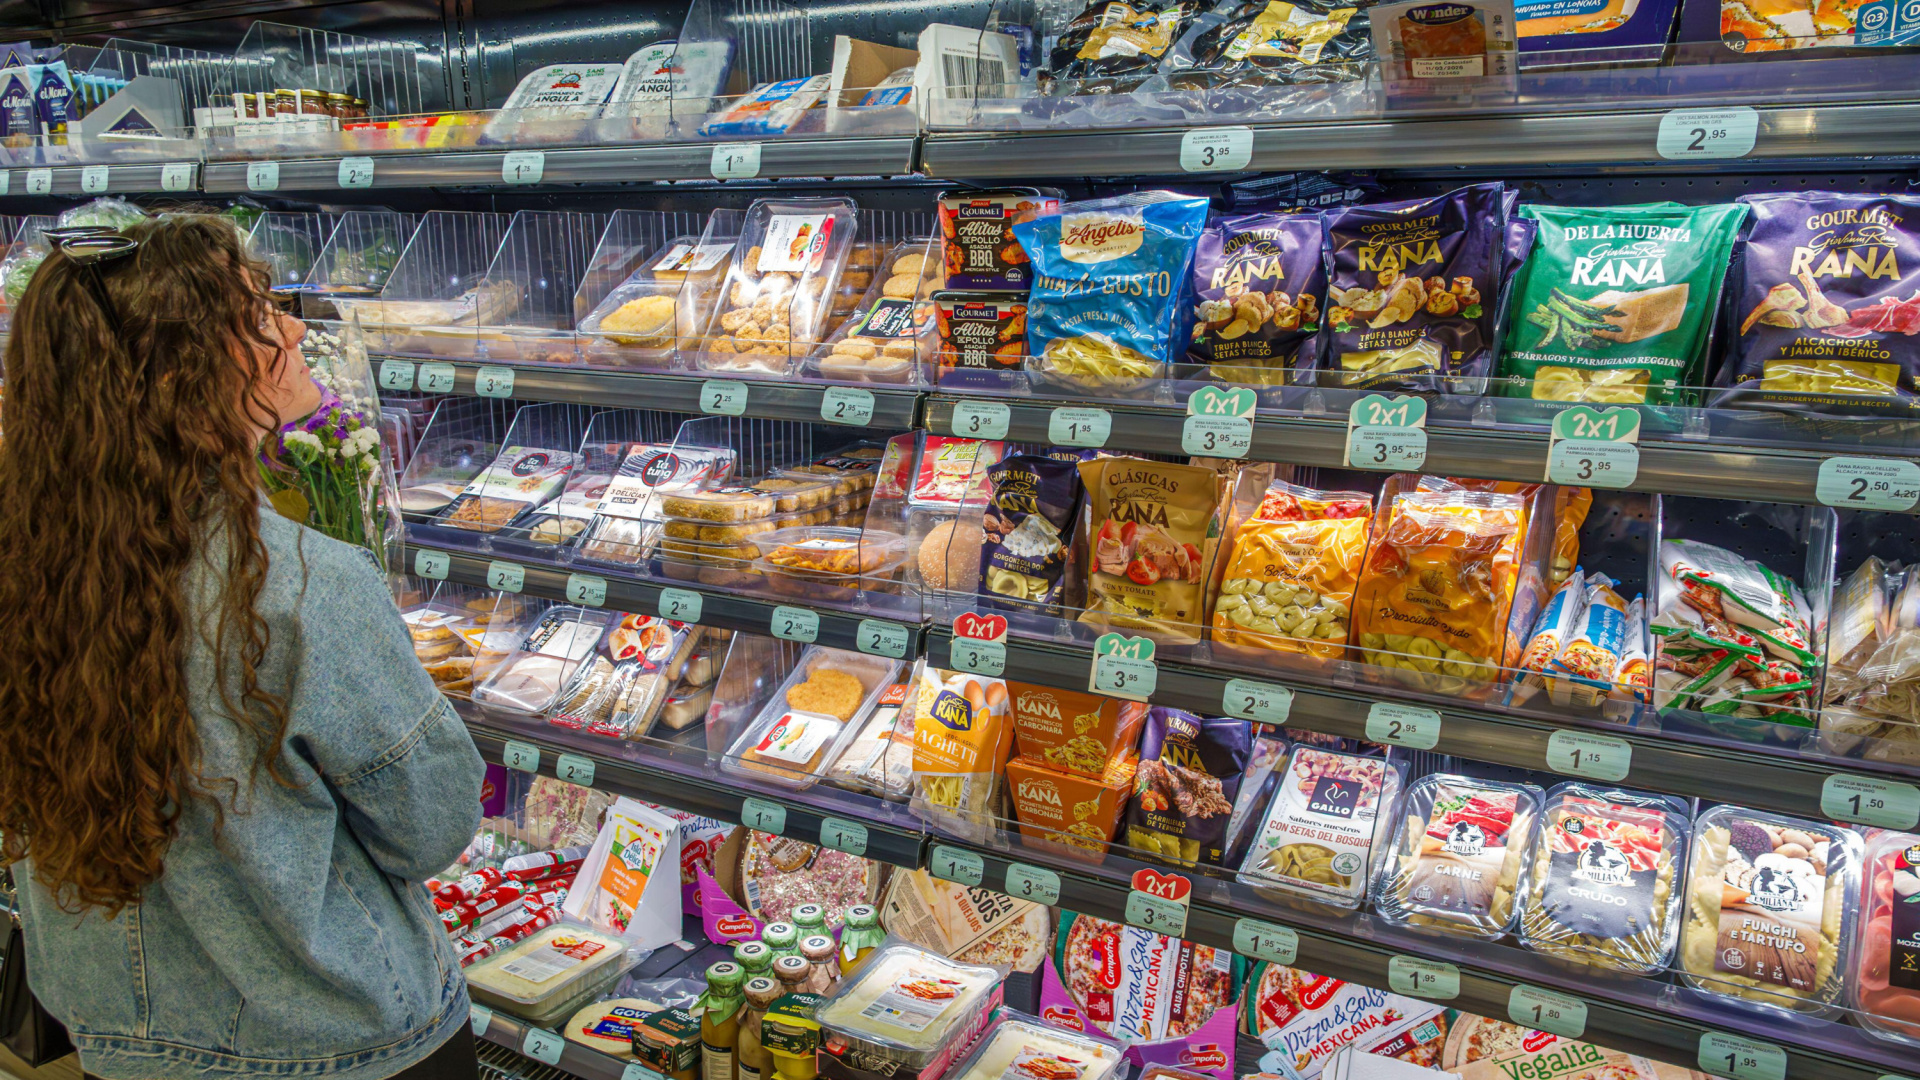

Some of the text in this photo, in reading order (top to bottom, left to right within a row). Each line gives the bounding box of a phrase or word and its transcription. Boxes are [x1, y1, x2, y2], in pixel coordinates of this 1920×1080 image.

[1412, 6, 1468, 20] Wonder
[1515, 4, 1551, 13] AHUMADO
[958, 221, 1003, 235] Alitas
[1361, 214, 1440, 234] GOURMET
[1806, 208, 1903, 231] GOURMET
[1065, 220, 1139, 246] Angelis
[1223, 229, 1283, 256] GOURMET
[1564, 224, 1692, 243] DE LA HUERTA
[970, 250, 993, 267] BBQ
[1358, 240, 1444, 272] RANA
[1789, 246, 1901, 281] RANA
[1211, 258, 1285, 289] RANA
[1570, 257, 1667, 286] RANA
[1102, 271, 1171, 298] GUSTO
[953, 322, 998, 336] Alitas
[1061, 311, 1109, 330] PASTA FRESCA
[1214, 342, 1240, 352] TRUFA
[1358, 339, 1384, 349] SETAS
[1360, 332, 1386, 342] TRUFA
[1794, 337, 1879, 349] ALCACHOFAS
[964, 350, 987, 367] BBQ
[1213, 351, 1237, 360] SETAS
[1247, 347, 1272, 357] QUESO
[1780, 344, 1891, 359] Y JAMÓN IBÉRICO
[1568, 356, 1686, 368] Y PARMIGIANO REGGIANO
[1204, 392, 1240, 415] 2x1
[1861, 400, 1890, 408] RECETA
[1368, 402, 1408, 426] 2x1
[1572, 413, 1619, 439] 2x1
[990, 470, 1040, 485] GOURMET
[1108, 468, 1179, 494] CLÁSICAS
[616, 489, 647, 499] DELICIAS
[1110, 500, 1170, 528] RANA
[1124, 585, 1156, 596] TOMATE
[966, 618, 995, 638] 2x1
[1379, 607, 1440, 629] Prosciutto
[934, 703, 968, 728] RANA
[1016, 698, 1063, 721] RANA
[1018, 719, 1063, 735] CARBONARA
[1018, 784, 1062, 806] RANA
[1019, 804, 1063, 821] CARBONARA
[1311, 802, 1351, 815] GALLO
[1269, 820, 1372, 848] CON SETAS DEL BOSQUE
[1323, 823, 1361, 834] nuestros
[624, 849, 641, 866] Délice
[631, 843, 642, 852] Isla
[1434, 865, 1482, 881] CARNE
[1145, 875, 1177, 898] 2x1
[1567, 887, 1628, 907] CRUDO
[1754, 896, 1793, 907] EMILIANA
[958, 899, 982, 933] QUEIJOS
[1742, 918, 1797, 939] FUNGHI
[1730, 931, 1806, 953] E TARTUFO
[1142, 947, 1164, 1022] MEXICANA
[1173, 947, 1190, 1015] SALSA CHIPOTLE
[1120, 976, 1144, 1037] Pizza
[1284, 1017, 1333, 1062] Pizza
[1309, 1014, 1382, 1060] MEXICANA
[1500, 1043, 1604, 1080] Vegalia
